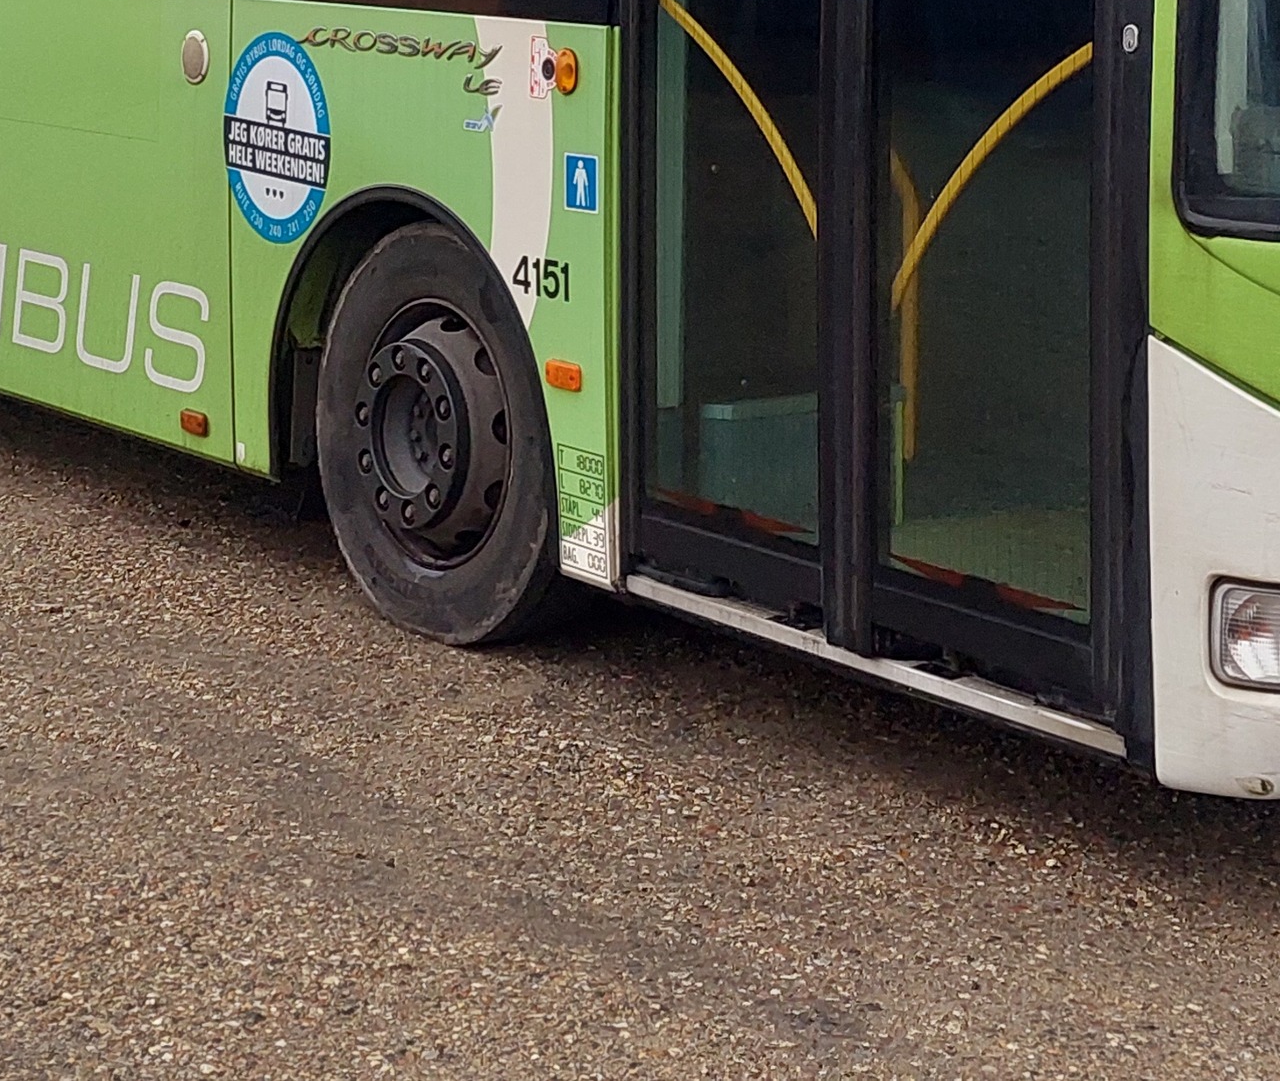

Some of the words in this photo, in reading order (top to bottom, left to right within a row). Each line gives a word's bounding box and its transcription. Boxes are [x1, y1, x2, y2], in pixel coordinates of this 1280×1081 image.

[296, 26, 503, 69] CROSSWAY
[230, 62, 247, 100] GRATIS
[245, 39, 267, 66] BYBUS
[268, 38, 296, 58] LØRDAG
[295, 52, 307, 70] OG
[305, 68, 326, 118] SØNDAG
[463, 74, 502, 96] LE
[228, 120, 247, 143] JEG
[249, 124, 285, 152] KØRER
[287, 133, 326, 160] GRATIS
[228, 143, 253, 167] HELE
[255, 149, 325, 184] WEEKENDEN!
[234, 181, 250, 211] RUTE
[303, 199, 316, 221] 250
[512, 255, 570, 303] 4151
[559, 449, 564, 465] T
[560, 473, 565, 489] L
[579, 478, 604, 500] 8270
[593, 530, 605, 549] 39
[587, 552, 606, 573] 000
